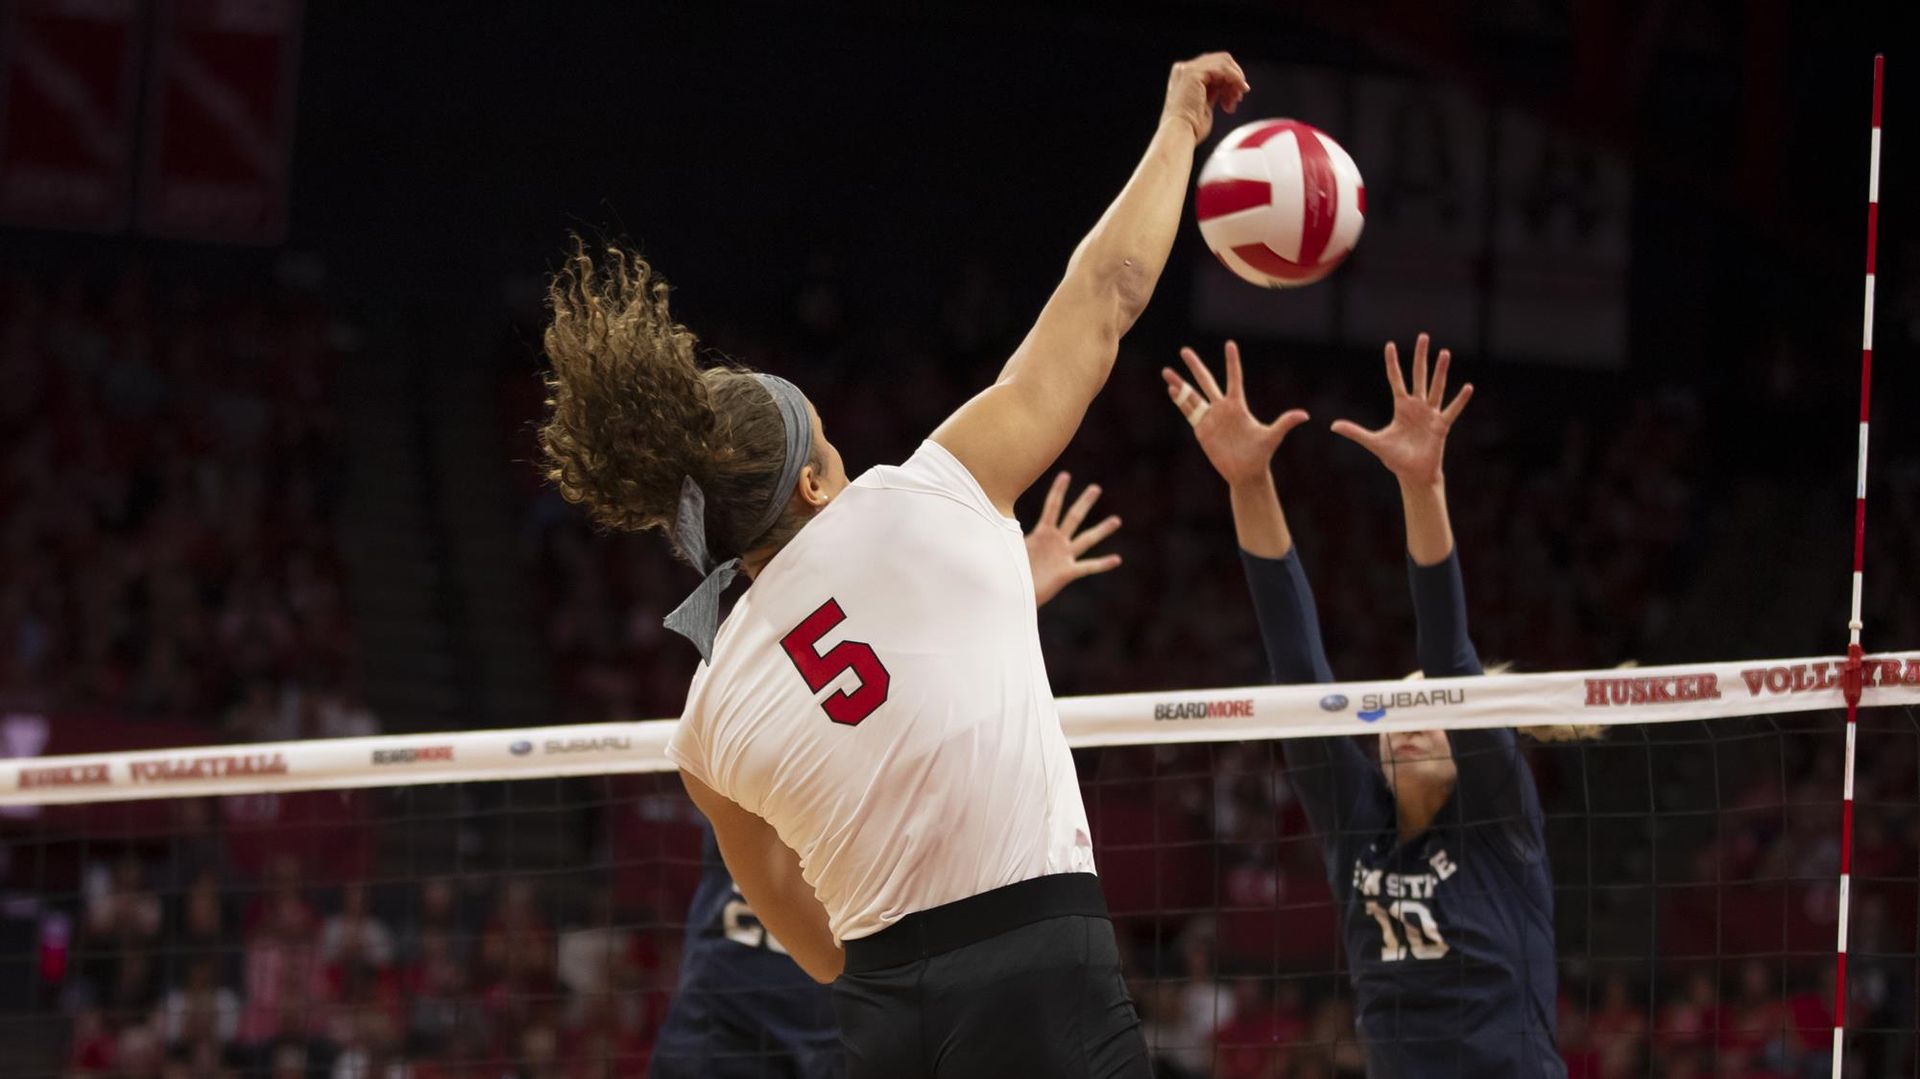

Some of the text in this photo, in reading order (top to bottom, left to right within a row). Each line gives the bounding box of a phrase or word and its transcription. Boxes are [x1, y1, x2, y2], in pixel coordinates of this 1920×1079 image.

[779, 597, 891, 727] 5
[1361, 688, 1465, 711] SUBARU
[1584, 673, 1722, 706] HUSKER
[1154, 699, 1255, 721] BEARDMORE
[544, 736, 631, 754] SUBARU
[1365, 900, 1451, 961] 10
